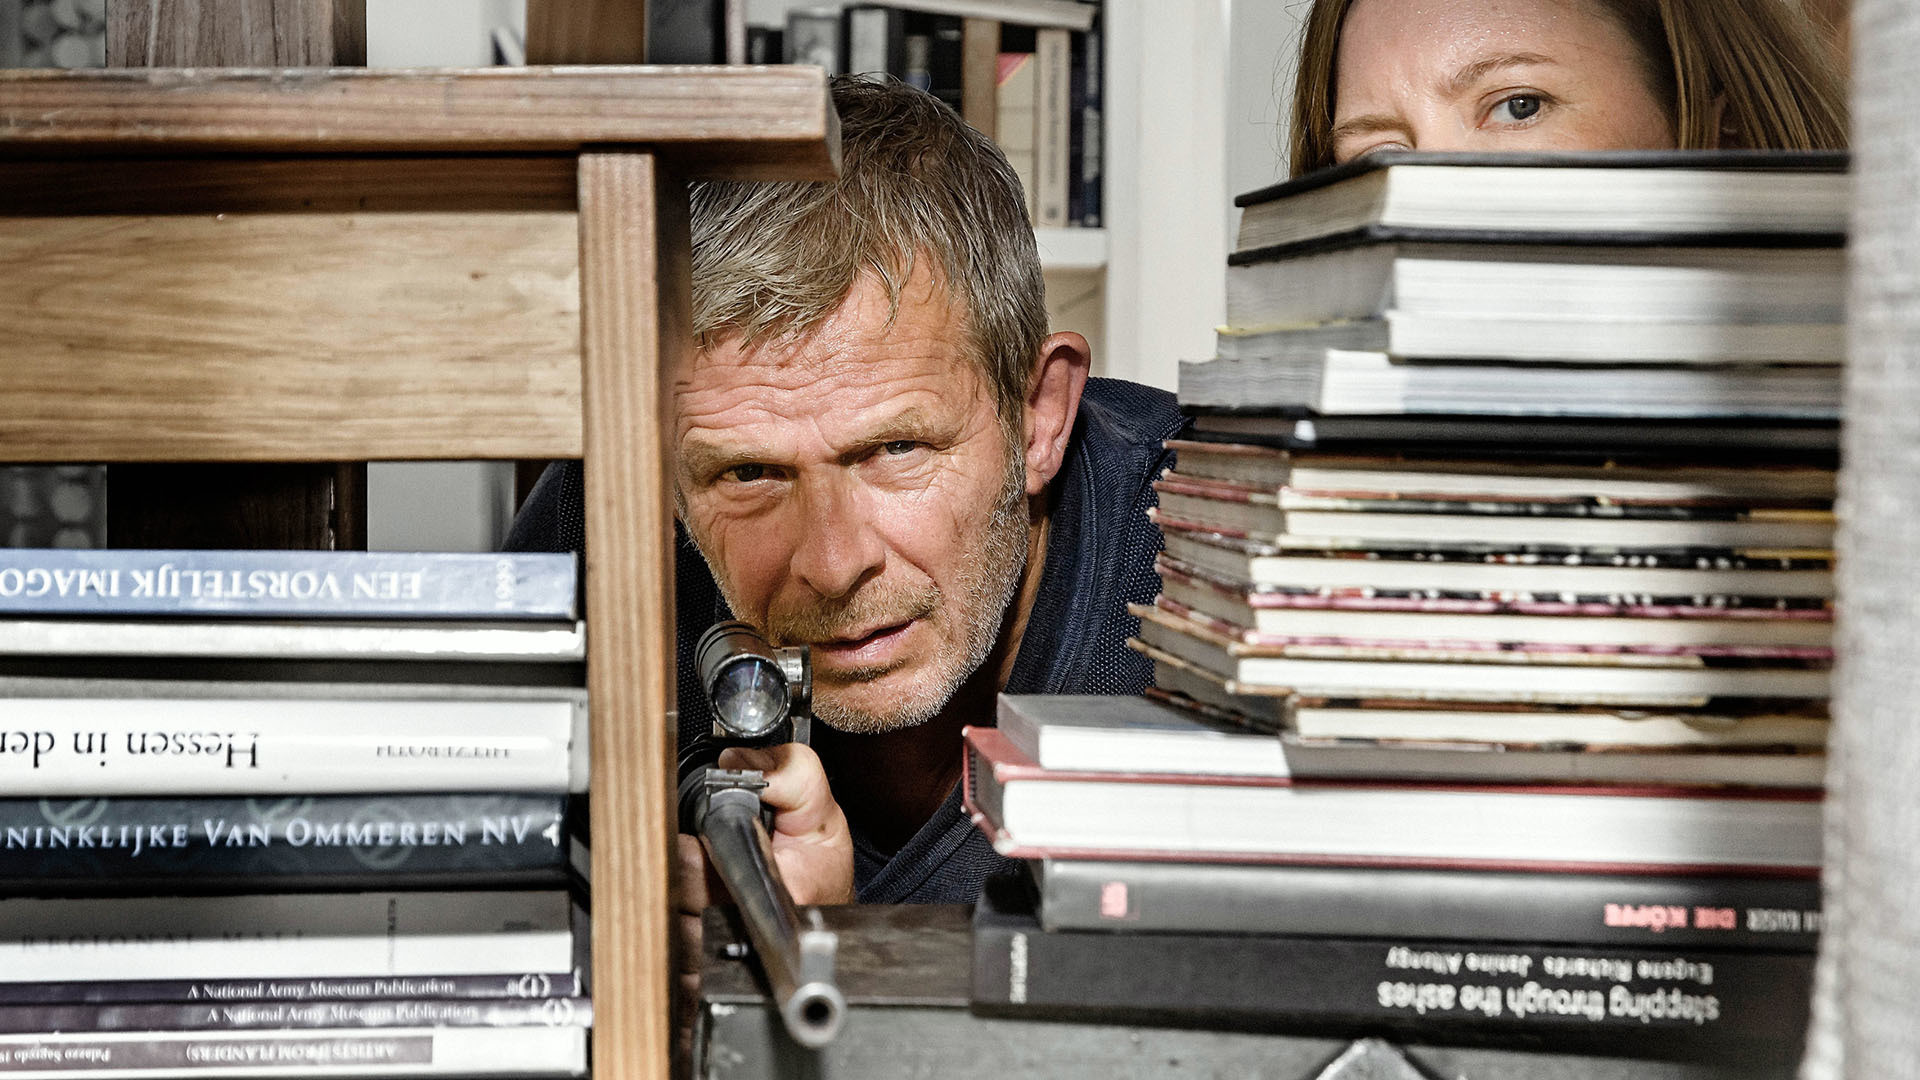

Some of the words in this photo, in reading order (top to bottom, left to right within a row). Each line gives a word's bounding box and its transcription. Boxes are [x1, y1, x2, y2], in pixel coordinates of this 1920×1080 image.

[0, 568, 119, 597] IMAGO
[130, 563, 342, 600] VORSTELIJK
[353, 569, 425, 599] EEN
[73, 732, 108, 767] in
[127, 731, 258, 768] Hessen
[0, 823, 190, 857] NINKLIJKE
[481, 815, 531, 846] NV
[187, 984, 198, 999] A
[203, 981, 263, 999] National
[266, 982, 302, 1000] Army
[308, 979, 370, 997] Museum
[373, 978, 456, 996] Publication
[1377, 981, 1456, 1015] ashes
[1460, 985, 1502, 1016] the
[1506, 981, 1605, 1021] through
[1609, 985, 1720, 1024] stepping
[207, 1007, 219, 1023] A
[222, 1003, 283, 1022] National
[286, 1004, 323, 1023] Army
[330, 1002, 393, 1020] Museum
[395, 1001, 479, 1020] Publication
[64, 1047, 111, 1063] Palazzo
